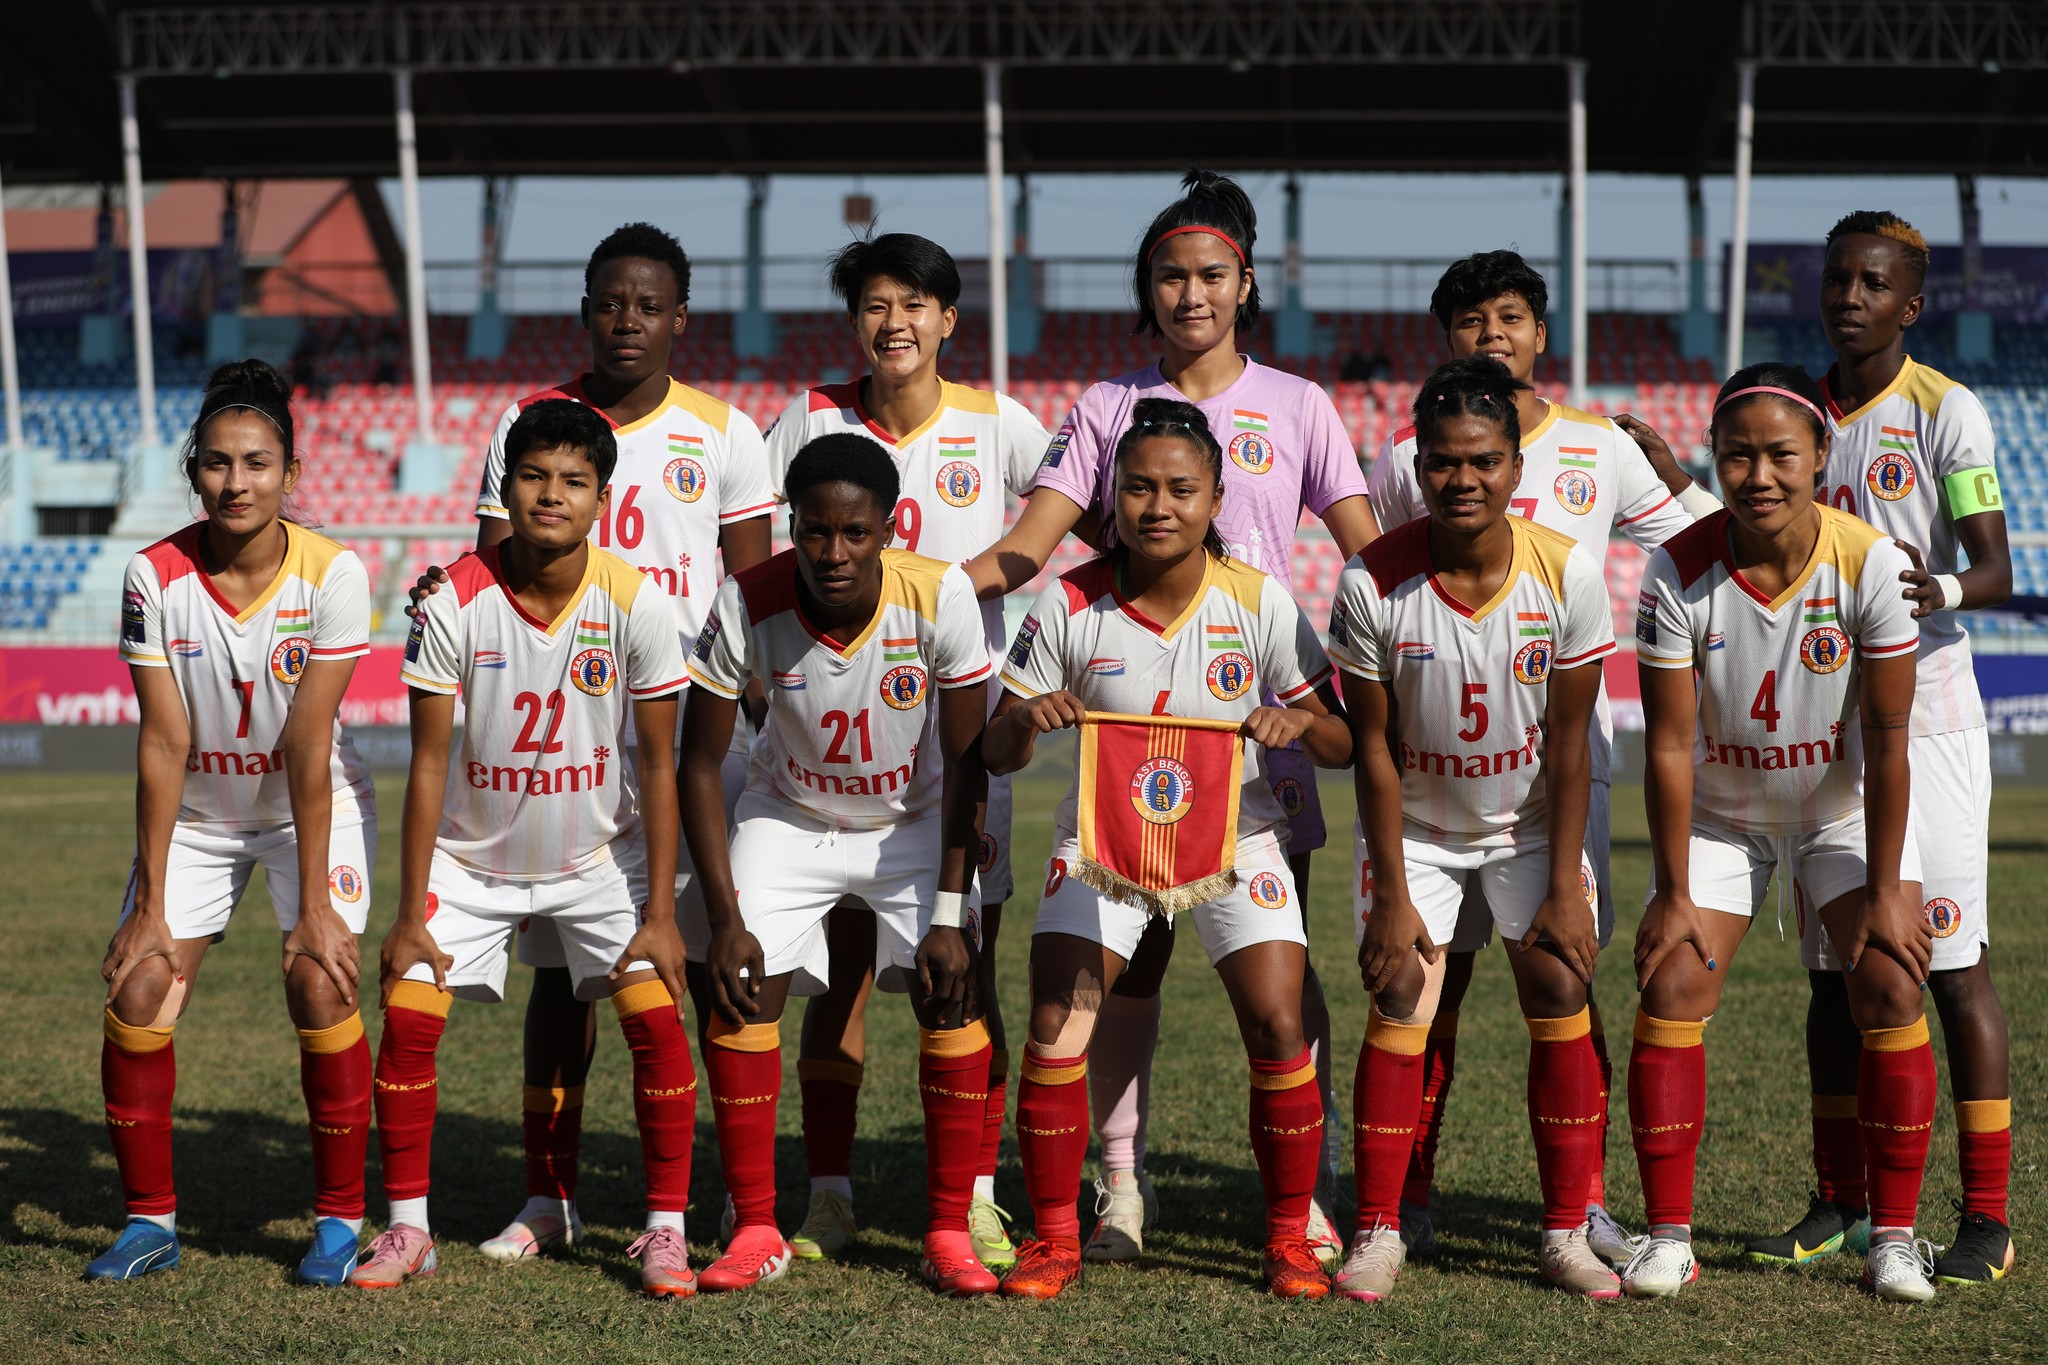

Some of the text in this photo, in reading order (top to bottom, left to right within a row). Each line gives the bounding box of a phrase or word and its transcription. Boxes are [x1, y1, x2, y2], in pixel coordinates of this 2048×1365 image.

[1232, 433, 1273, 458] EAST BENGAL
[665, 460, 704, 483] EAST BENGAL
[938, 462, 980, 487] EAST BENGAL
[1555, 472, 1571, 488] EAST
[1869, 455, 1914, 480] EAST BENGAL
[1883, 492, 1894, 500] FC
[1974, 473, 1999, 507] C
[599, 484, 645, 550] 16
[894, 497, 922, 553] 9
[1802, 629, 1847, 651] EAST BENGAL
[273, 642, 289, 664] EAST
[572, 652, 590, 671] EAST
[1517, 645, 1533, 664] EAST
[882, 667, 926, 690] EAST BENGAL
[1208, 655, 1252, 678] EAST BENGAL
[231, 680, 254, 738] 7
[1458, 683, 1489, 743] 5
[1750, 670, 1780, 733] 4
[511, 689, 566, 754] 22
[821, 708, 873, 764] 21
[1133, 759, 1193, 795] EAST BENGAL
[1153, 813, 1168, 823] FC
